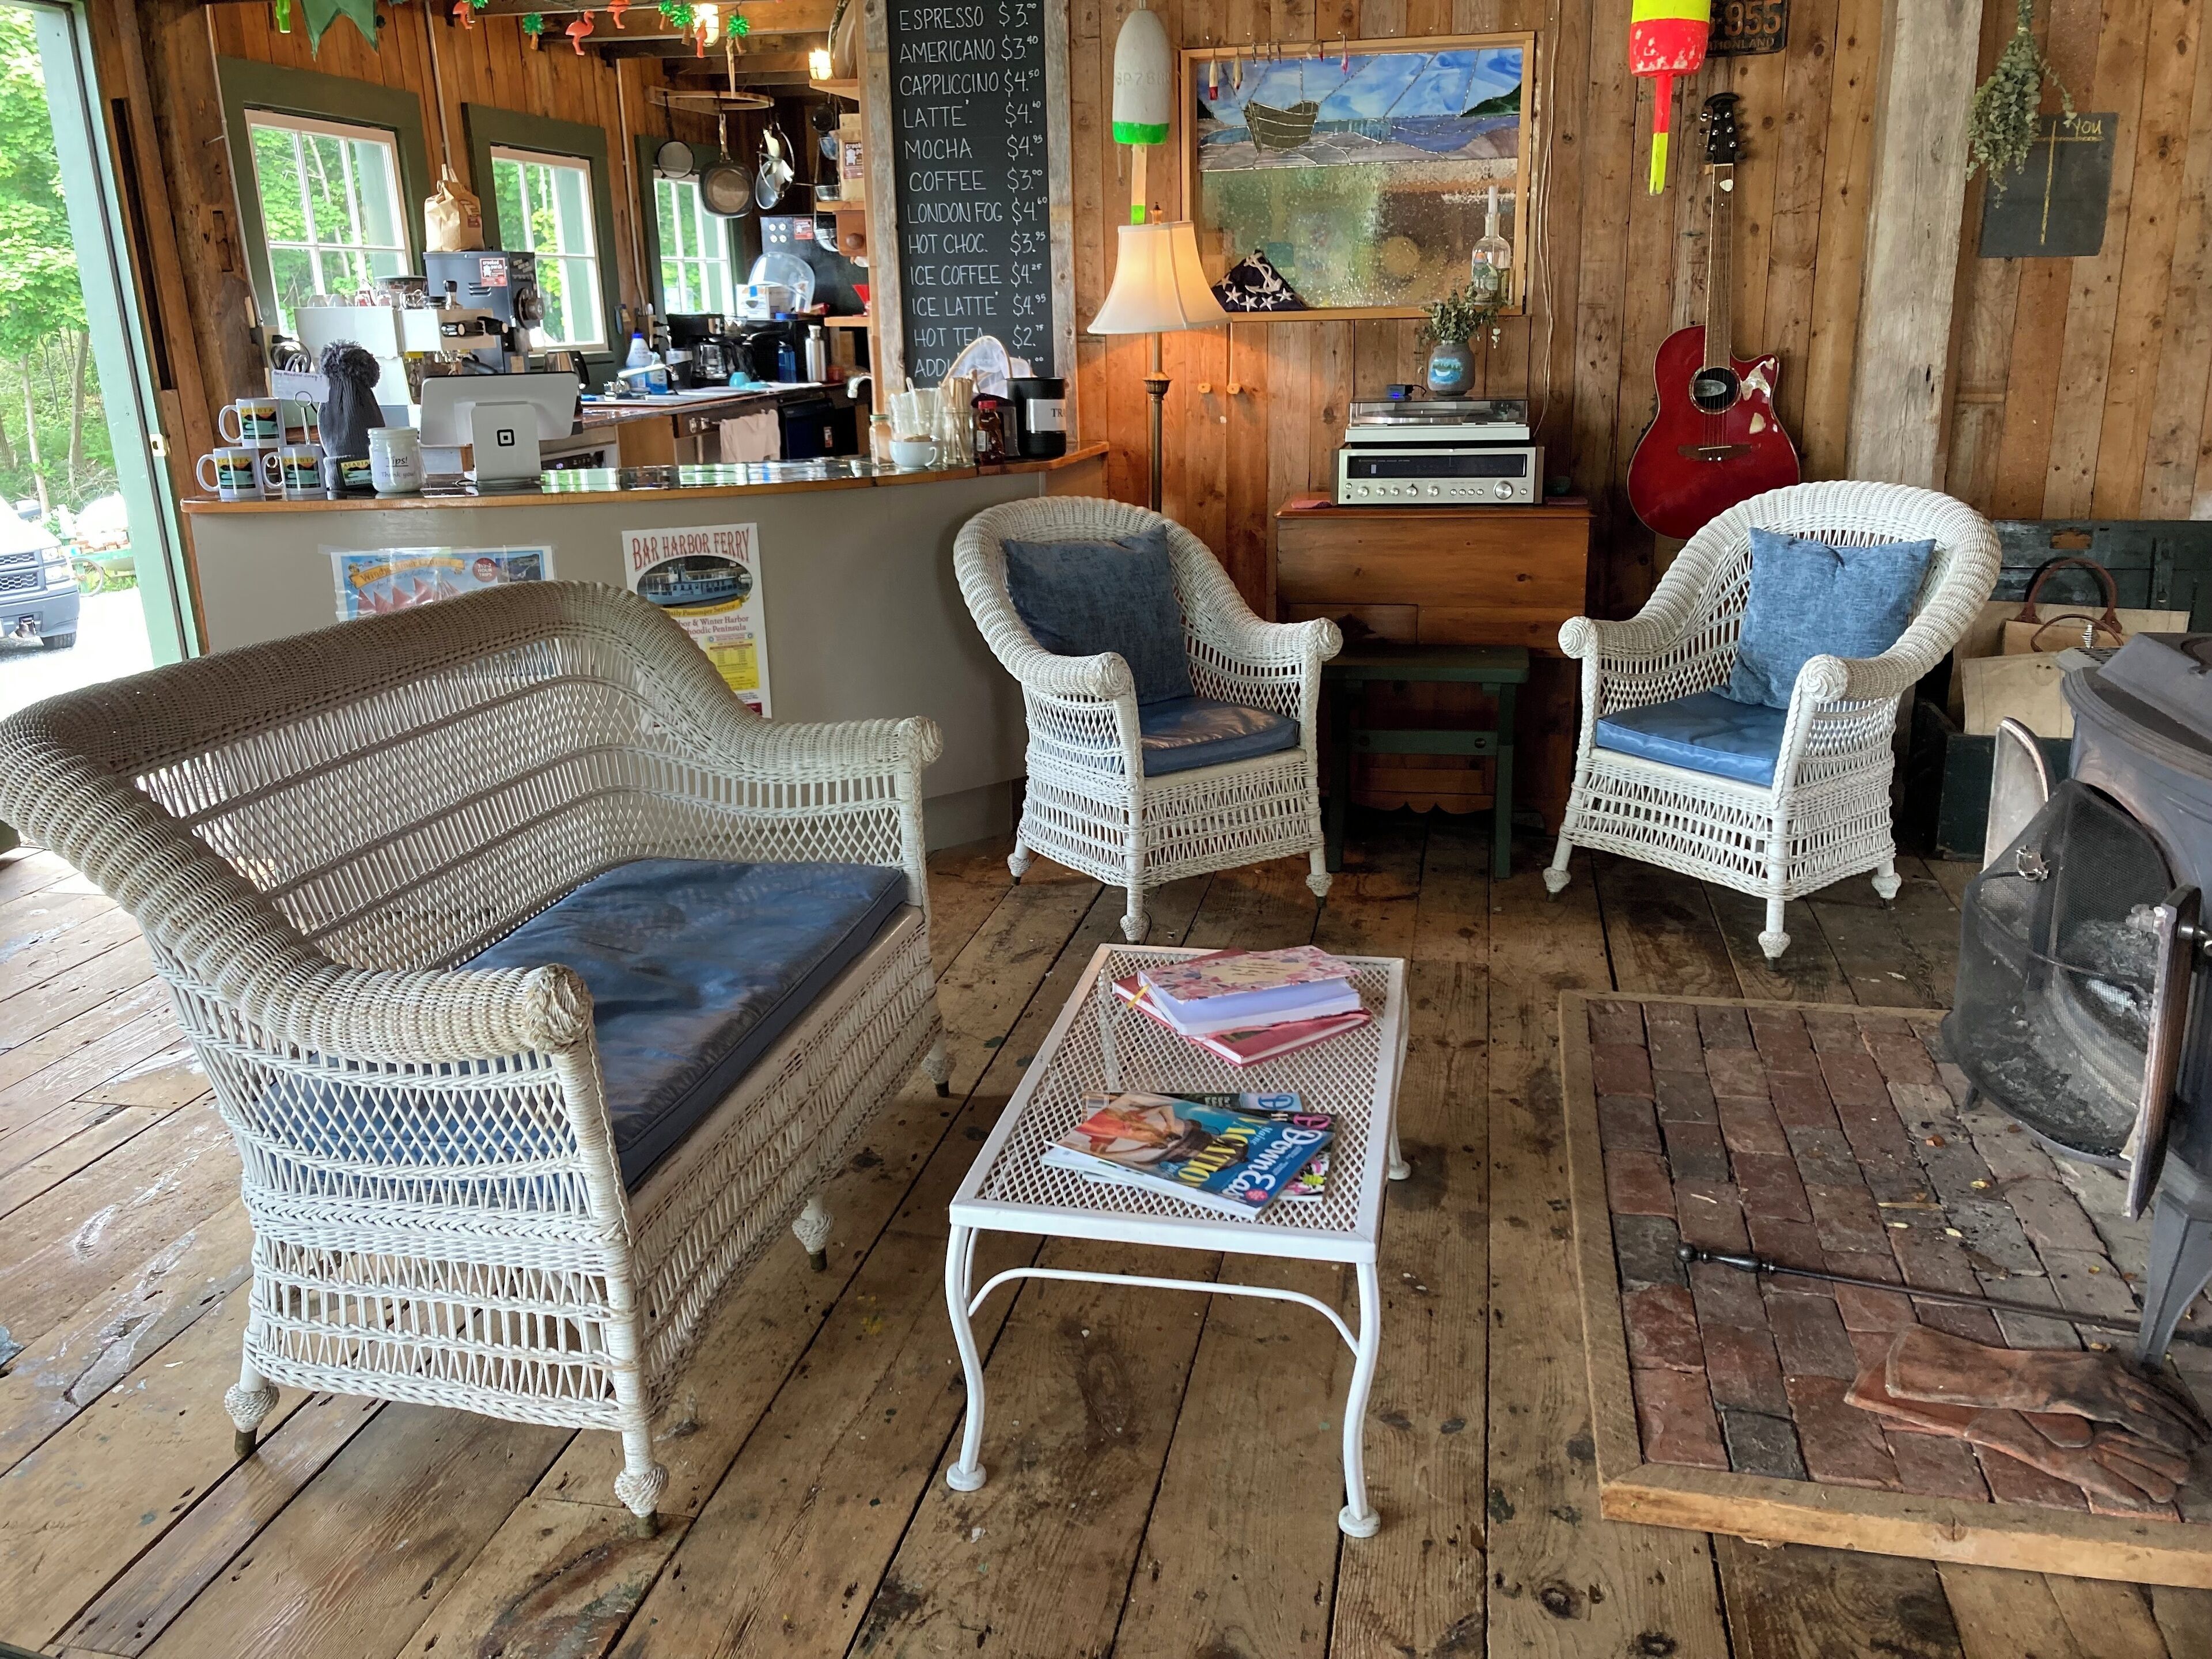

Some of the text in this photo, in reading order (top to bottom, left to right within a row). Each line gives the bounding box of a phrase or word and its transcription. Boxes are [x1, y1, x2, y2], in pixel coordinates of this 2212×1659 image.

[899, 6, 984, 31] ESPRESSO
[899, 39, 995, 63] AMERICANO
[899, 72, 999, 96] CAPPUCCINO
[905, 138, 973, 160] MOCHA
[909, 170, 987, 192] COFFEE
[907, 202, 971, 224] LONDON
[975, 202, 1003, 223] FOG
[908, 234, 938, 254] HOT
[943, 234, 989, 253] CHOC.
[910, 266, 936, 286] ICE
[941, 264, 1002, 286] COFFEE
[912, 297, 940, 317] ICE
[914, 328, 947, 347] HOT
[632, 527, 750, 572] BAR HARBOR FERRY
[713, 604, 736, 613] Service
[687, 623, 747, 635] hoodic Peninsula
[699, 617, 724, 625] Winter
[724, 615, 750, 623] Harbor
[1247, 1127, 1323, 1171] Down
